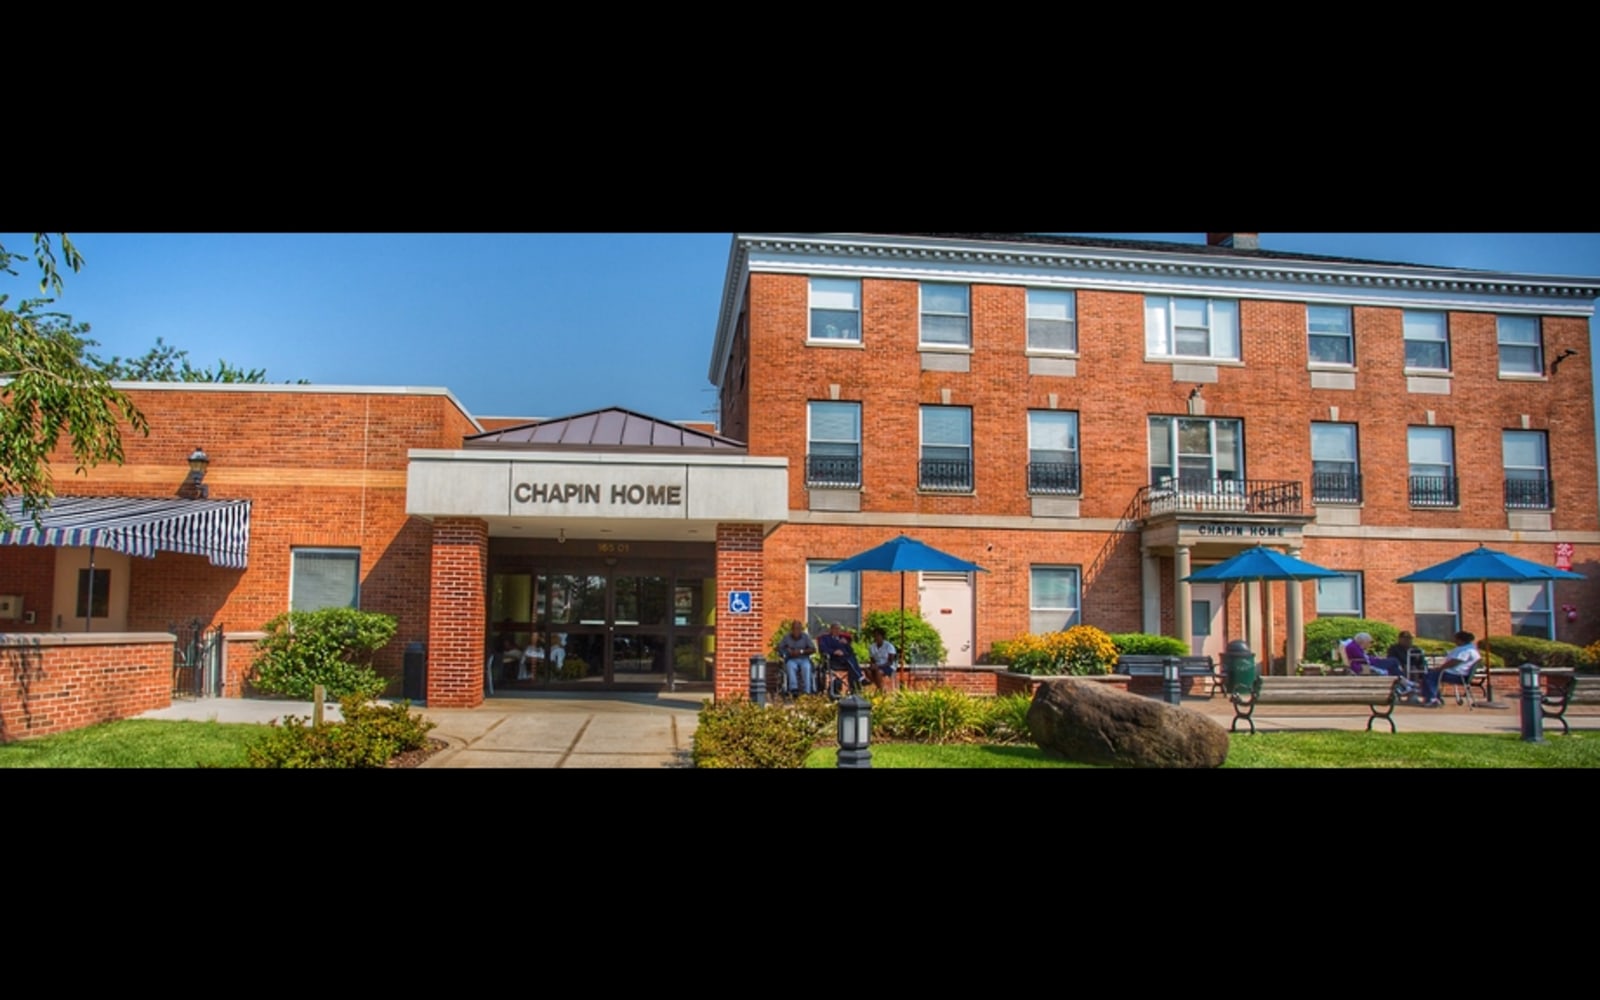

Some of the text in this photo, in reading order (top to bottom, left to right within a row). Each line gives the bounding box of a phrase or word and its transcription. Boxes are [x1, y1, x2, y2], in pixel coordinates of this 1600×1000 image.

[514, 483, 682, 505] CHAPIN HOME
[1198, 525, 1285, 537] CHAPIN HOME
